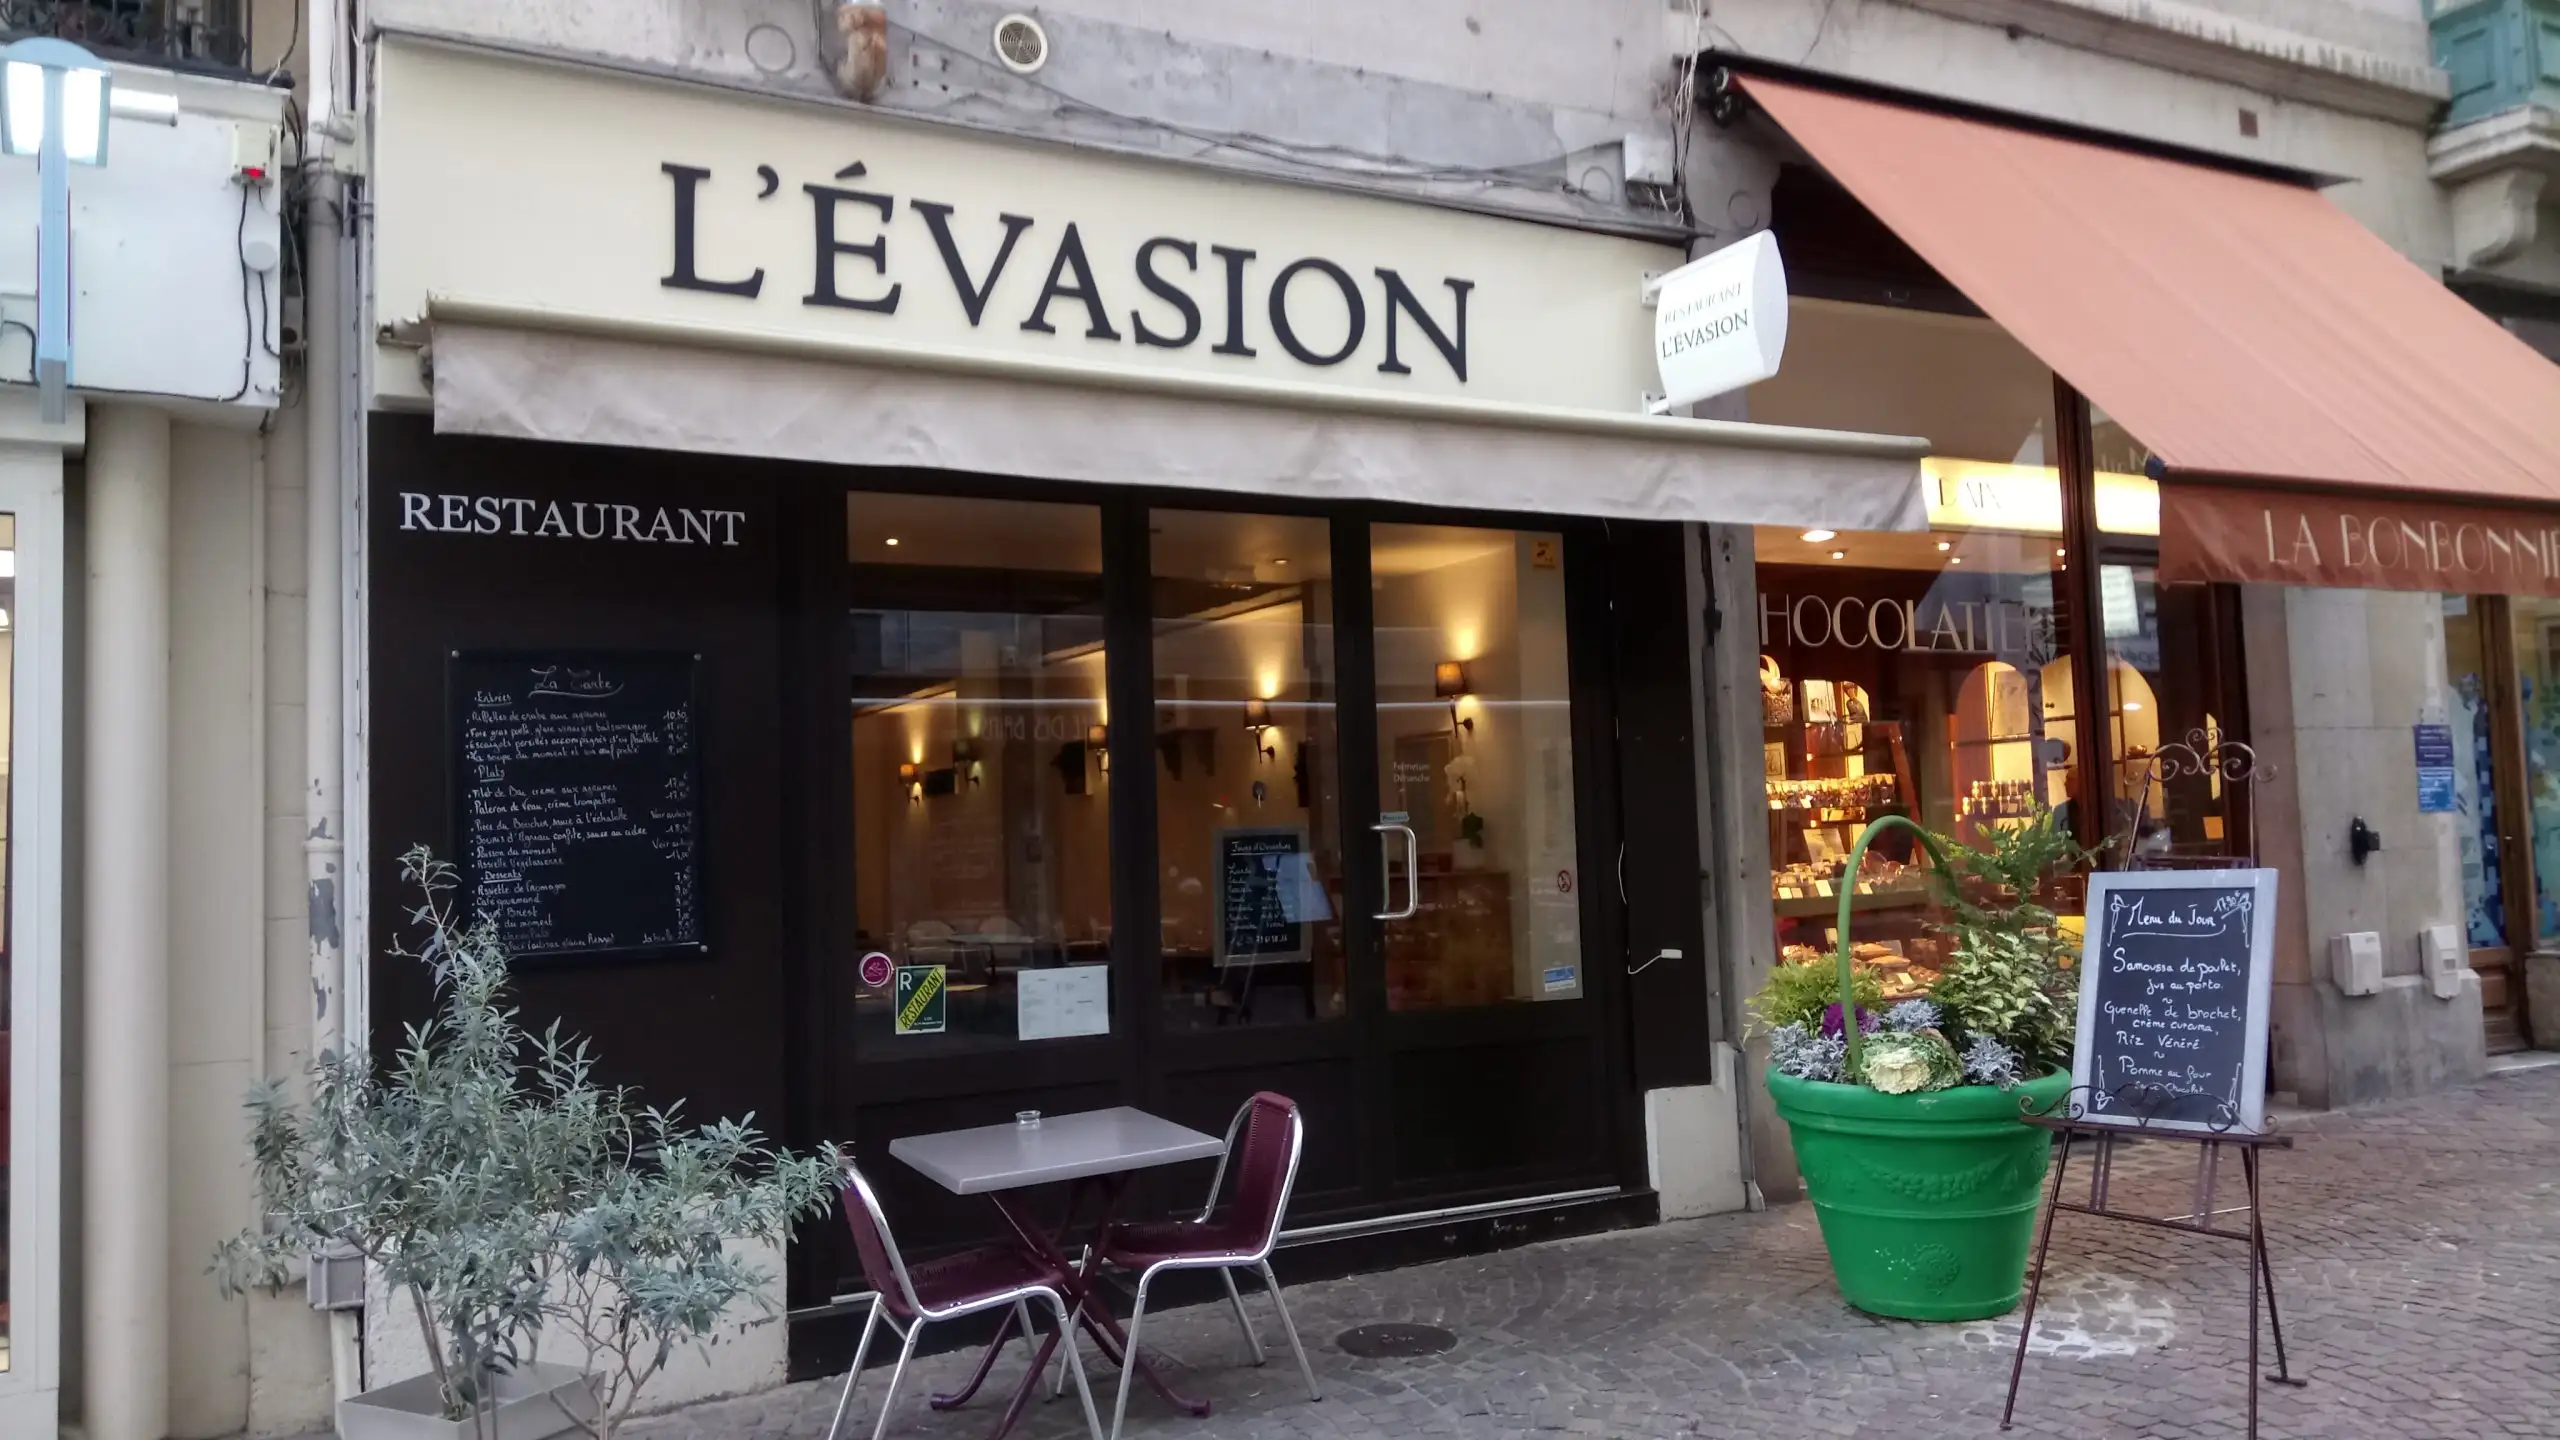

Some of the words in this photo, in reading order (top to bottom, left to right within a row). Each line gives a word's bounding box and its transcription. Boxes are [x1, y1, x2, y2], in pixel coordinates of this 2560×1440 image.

[661, 161, 1475, 383] L'ÉVASION
[1664, 282, 1741, 324] RESTAURANT
[400, 490, 747, 547] RESTAURANT
[2264, 510, 2321, 566] LA
[2128, 896, 2163, 926] Menu
[2168, 911, 2182, 924] du
[2187, 904, 2216, 926] Jour
[2113, 947, 2174, 973] Samoussa
[2180, 957, 2195, 973] de
[899, 972, 912, 991] R
[2147, 978, 2165, 995] jus
[2170, 982, 2184, 990] au
[900, 971, 943, 1029] RESTAURANT
[2164, 1004, 2179, 1018] de
[2132, 1018, 2165, 1029] crème
[2116, 1031, 2144, 1046] Riz
[2158, 1034, 2200, 1050] Vénéré
[2119, 1055, 2163, 1076] Pomme
